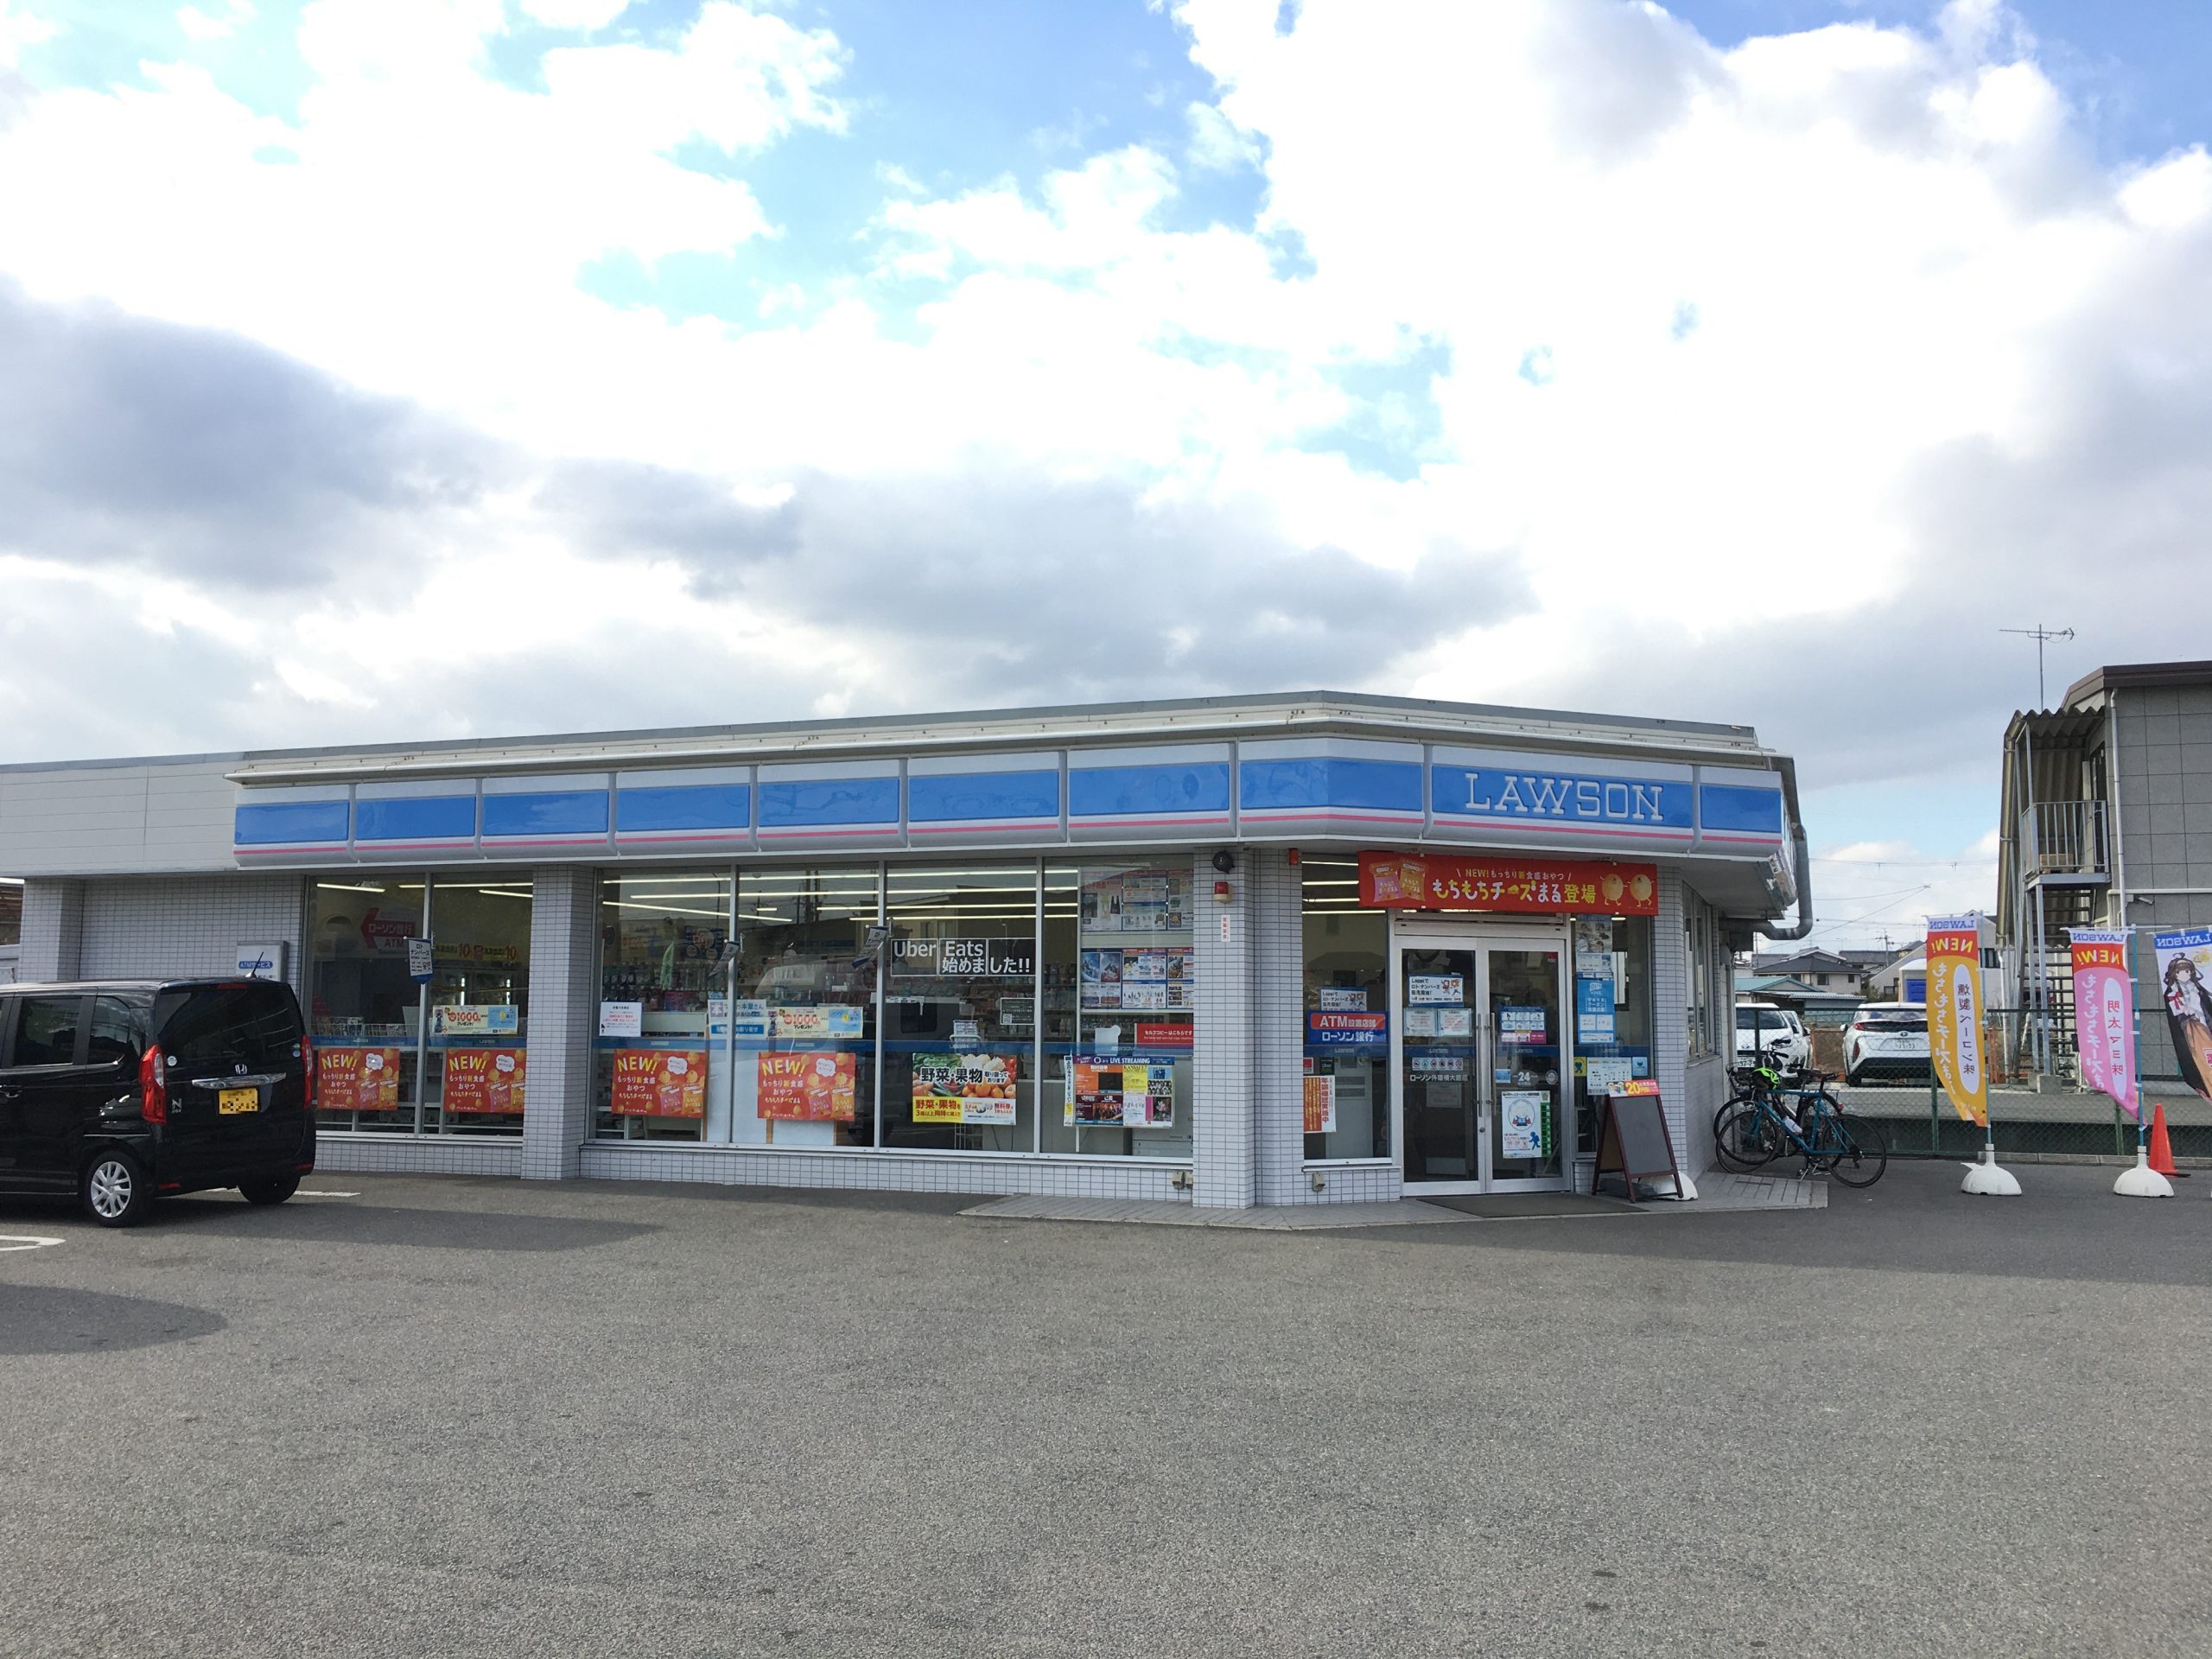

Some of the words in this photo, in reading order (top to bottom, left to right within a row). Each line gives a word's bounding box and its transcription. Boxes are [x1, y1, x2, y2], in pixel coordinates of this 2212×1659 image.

[1465, 772, 1664, 821] LAWSON
[1465, 868, 1490, 878] NEW!
[385, 938, 404, 948] ATM
[893, 941, 937, 957] Uber
[944, 940, 983, 957] Eats
[942, 957, 1030, 974] 始めました!!
[1322, 1031, 1375, 1042] ローソン銀行
[321, 1053, 357, 1071] NEW!
[449, 1055, 486, 1073] NEW!
[617, 1056, 658, 1074] NEW!
[761, 1058, 806, 1077] NEW!
[920, 1067, 983, 1084] 野菜・果物
[1517, 1071, 1530, 1081] 24
[1625, 1082, 1641, 1094] 20
